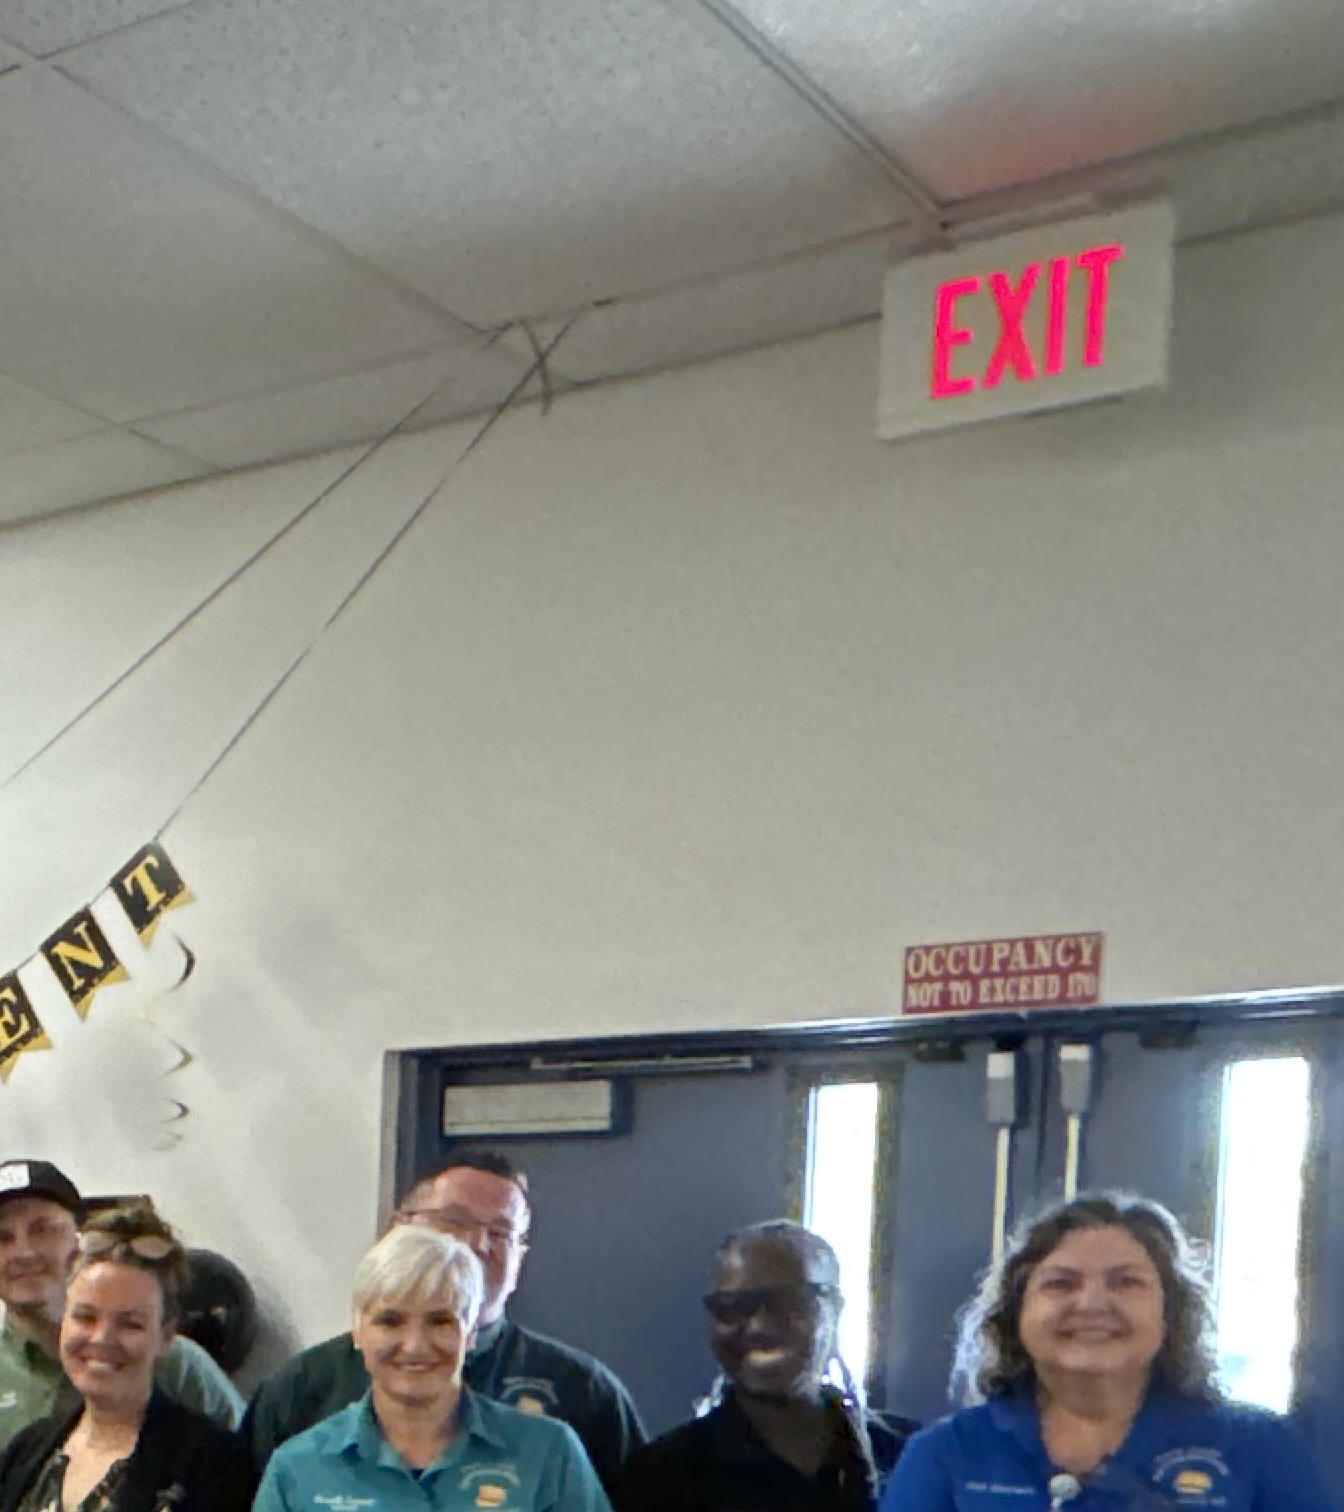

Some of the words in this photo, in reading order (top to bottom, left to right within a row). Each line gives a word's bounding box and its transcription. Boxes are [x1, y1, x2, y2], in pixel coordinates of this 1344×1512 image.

[932, 244, 1123, 399] EXIT
[908, 935, 1097, 977] OCCUPANCY
[906, 982, 944, 1008] NOT
[948, 980, 972, 1006] TO
[979, 974, 1060, 1003] EXCEED
